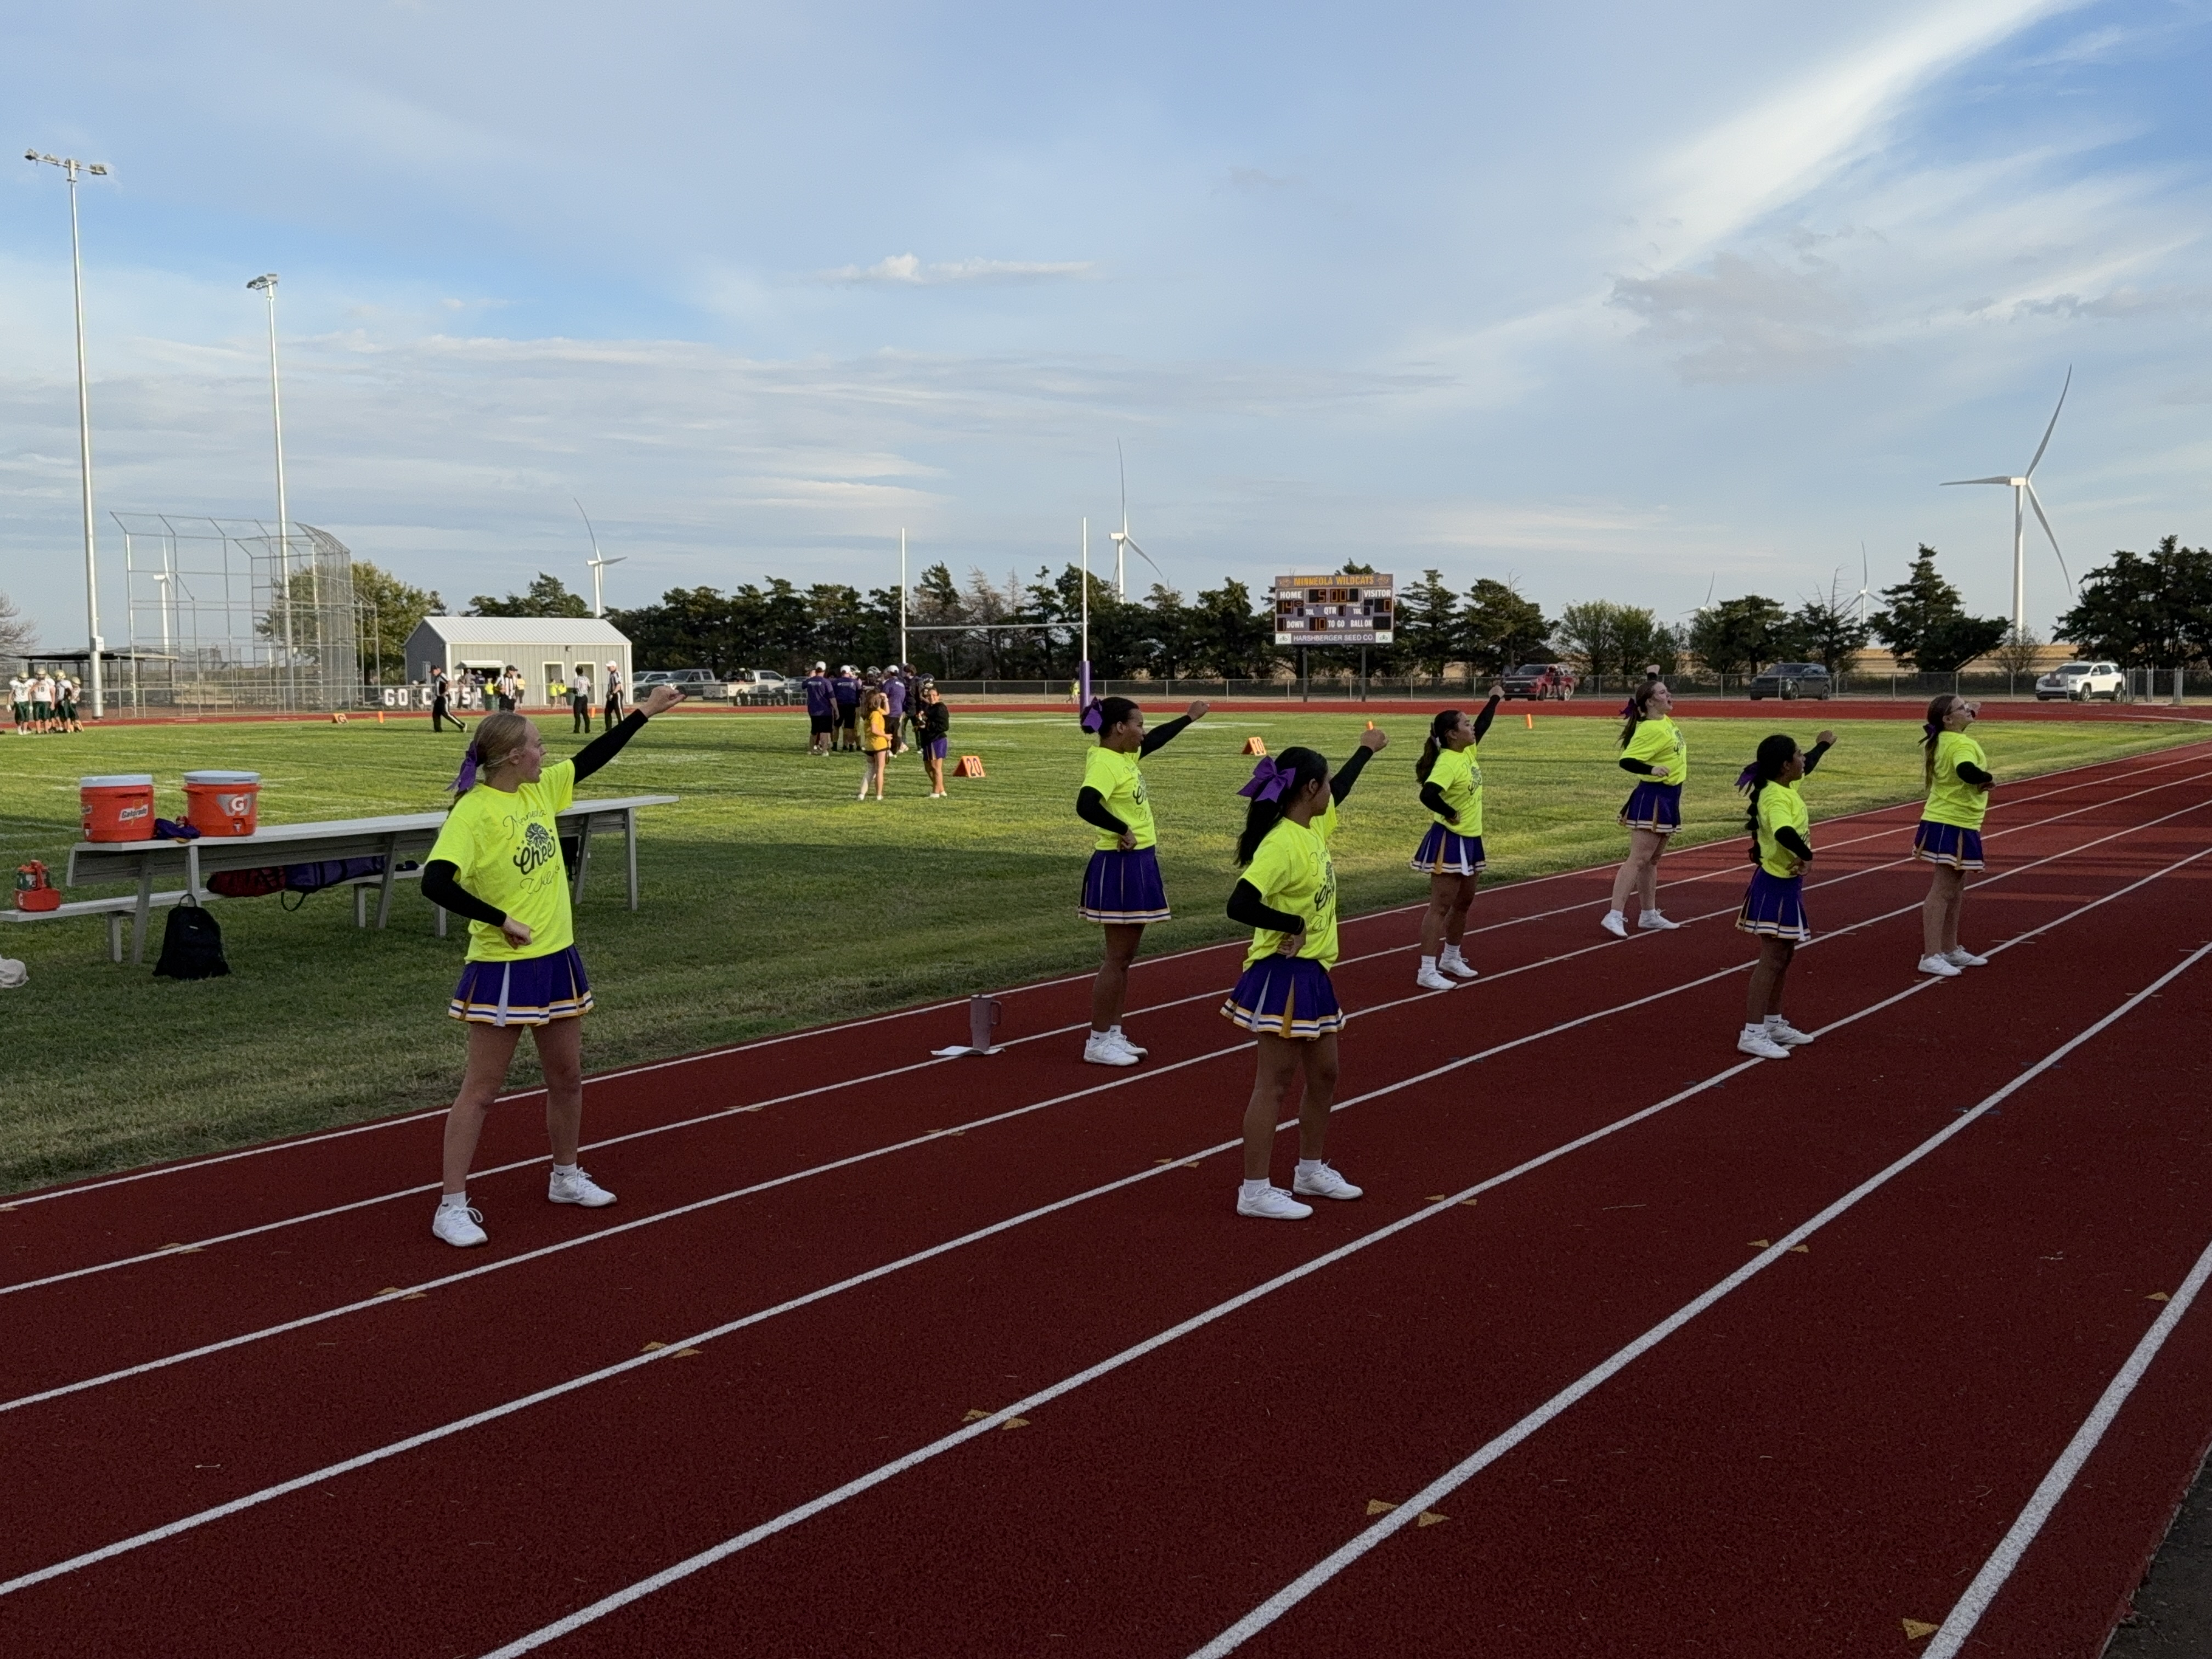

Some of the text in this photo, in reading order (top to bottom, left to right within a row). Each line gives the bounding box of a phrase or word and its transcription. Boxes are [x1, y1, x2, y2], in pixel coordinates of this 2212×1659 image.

[1294, 575, 1374, 586] MINNEOLA WILDCATS
[1280, 591, 1302, 599] HOME
[1282, 601, 1293, 613] 14
[1324, 607, 1336, 615] QTR
[1384, 599, 1391, 612] 0
[1315, 618, 1325, 630] 10
[1337, 619, 1345, 628] GO
[1350, 619, 1363, 628] BALL
[385, 687, 482, 706] GO CTS!
[337, 714, 347, 723] G
[1252, 738, 1265, 754] 10
[967, 758, 981, 776] 20
[232, 797, 245, 811] G
